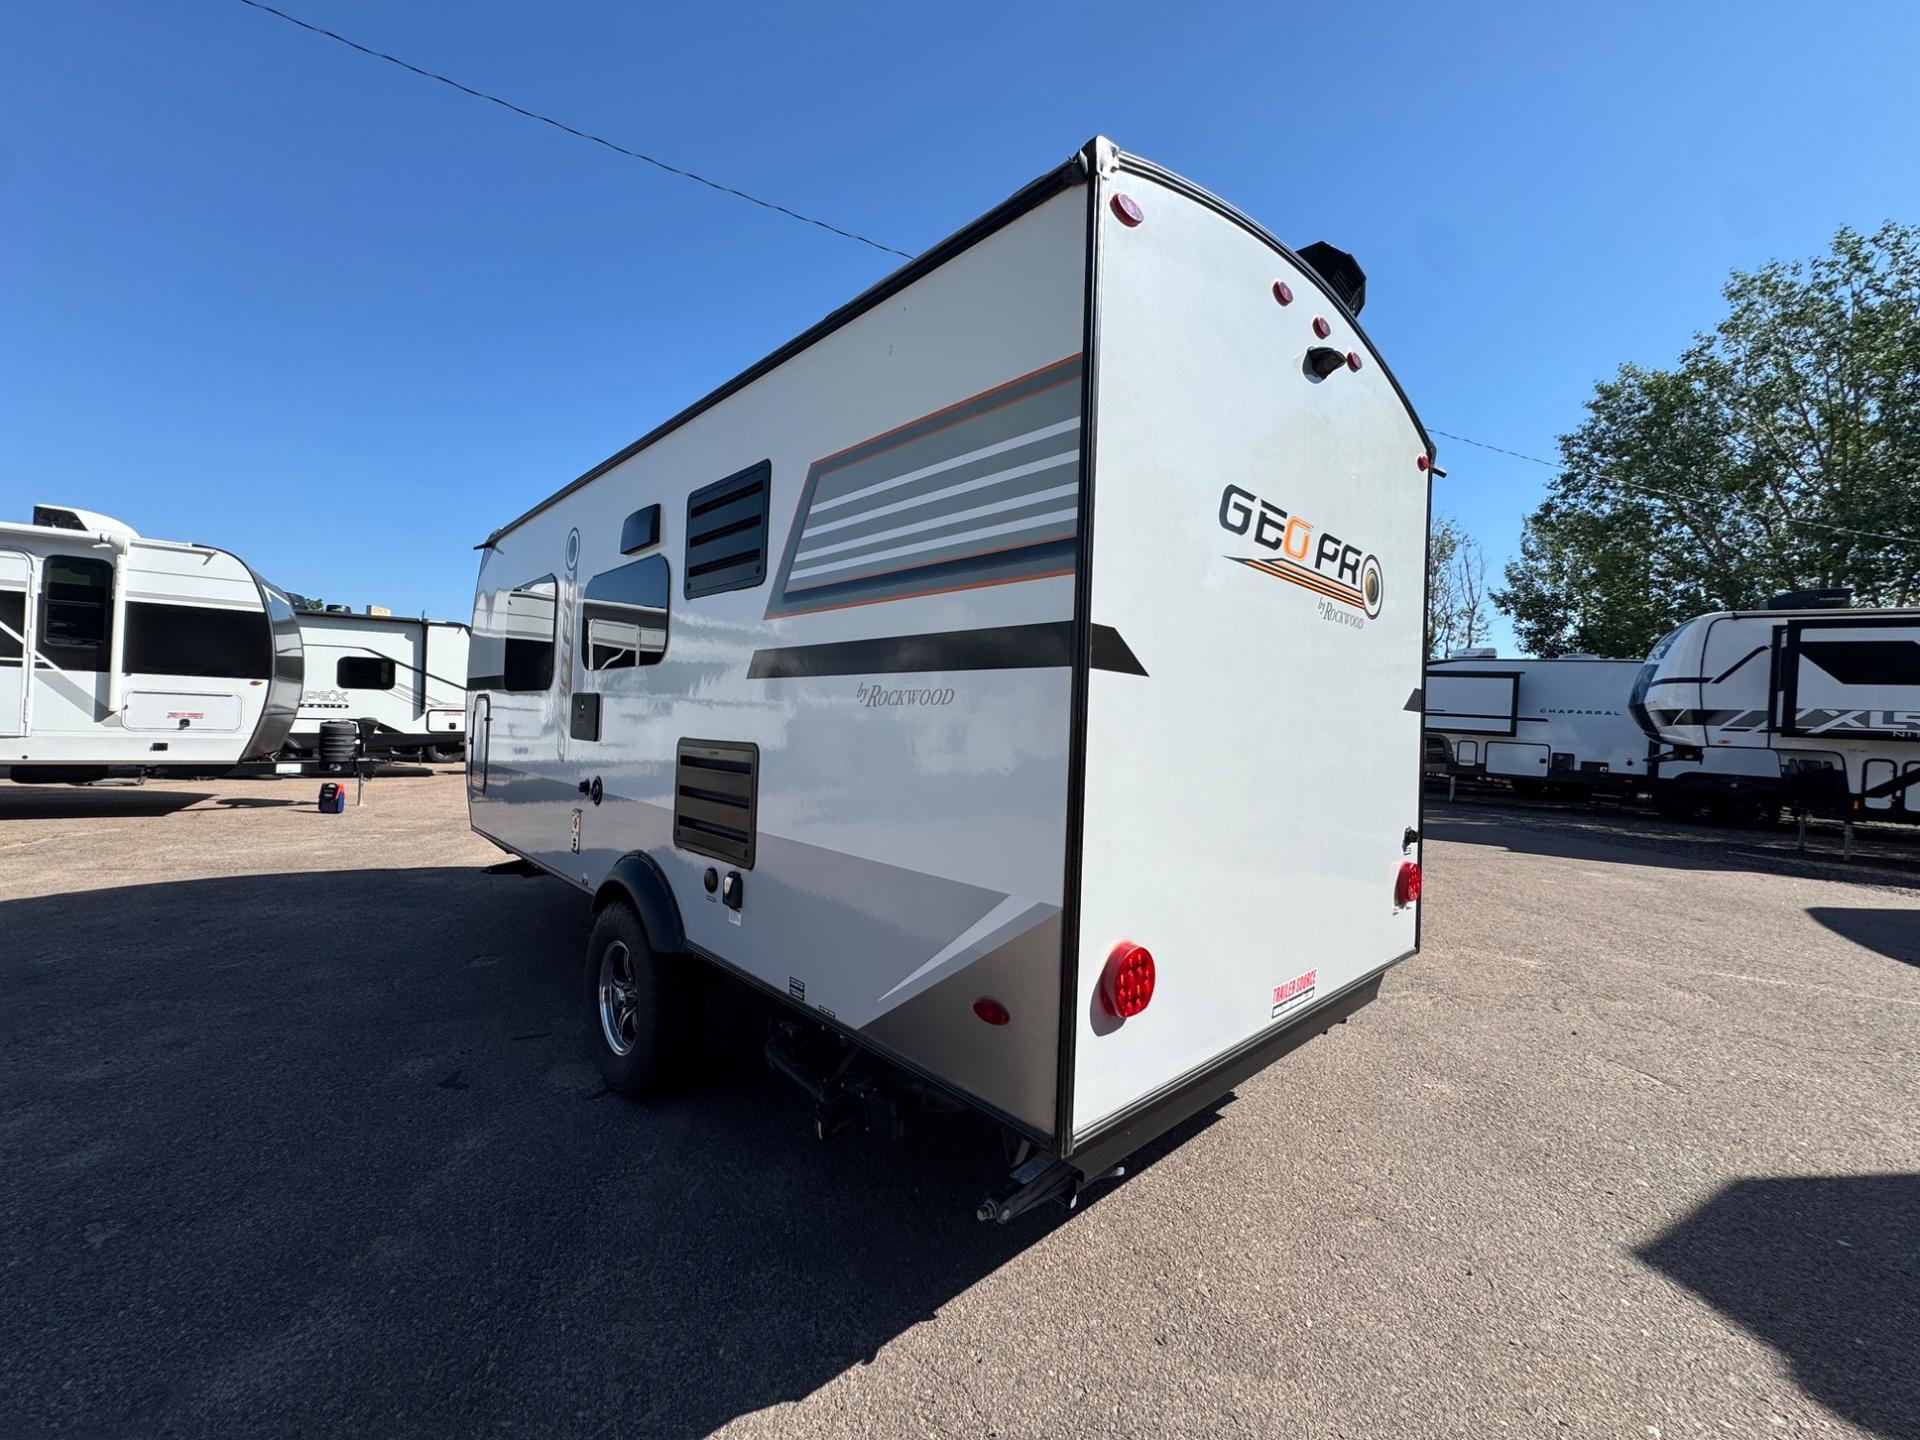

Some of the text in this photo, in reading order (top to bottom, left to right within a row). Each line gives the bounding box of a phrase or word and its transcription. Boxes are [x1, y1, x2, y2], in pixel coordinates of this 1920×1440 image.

[1219, 484, 1383, 620] GEO PRO
[303, 689, 349, 702] PEX
[857, 682, 955, 708] by ROCKWOOD
[1540, 708, 1621, 716] CHAPARRAL
